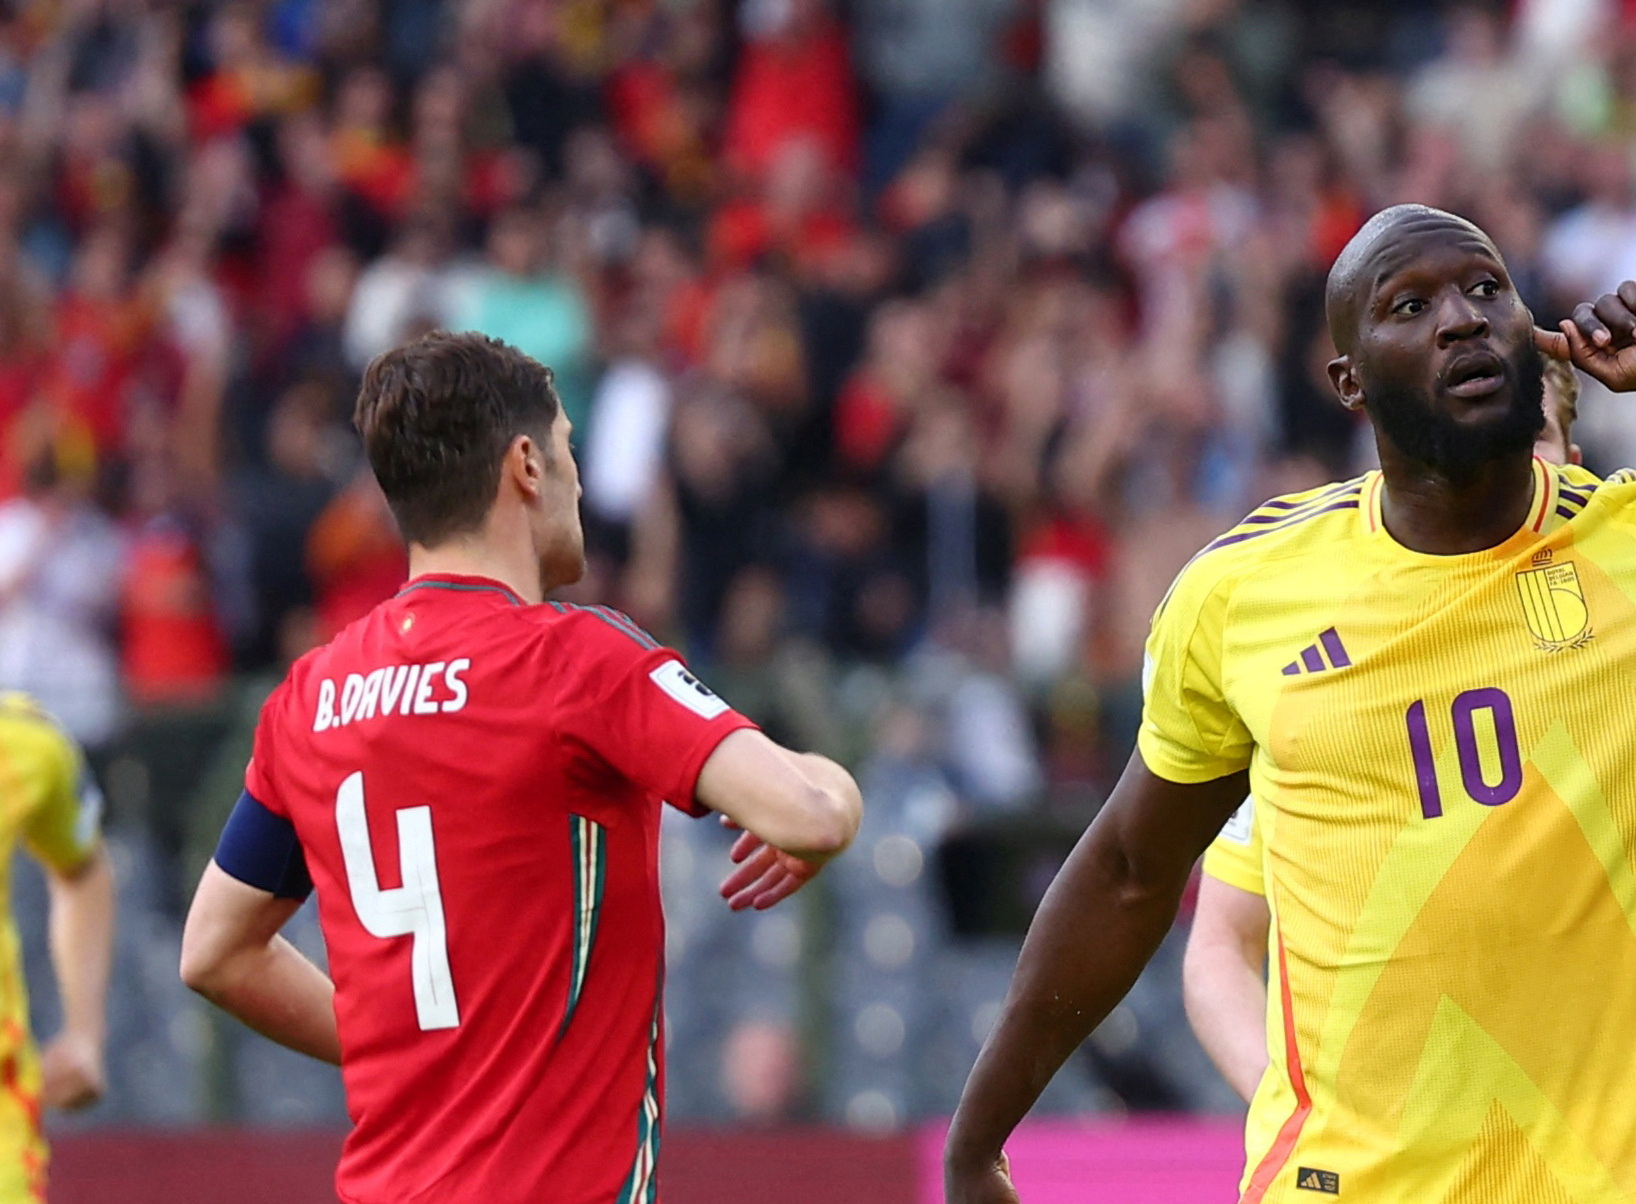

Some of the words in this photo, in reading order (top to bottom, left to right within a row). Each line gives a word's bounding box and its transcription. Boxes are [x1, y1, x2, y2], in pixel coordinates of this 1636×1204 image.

[313, 658, 470, 732] B.DAVIES
[1406, 687, 1523, 819] 10
[335, 771, 460, 1031] 4
